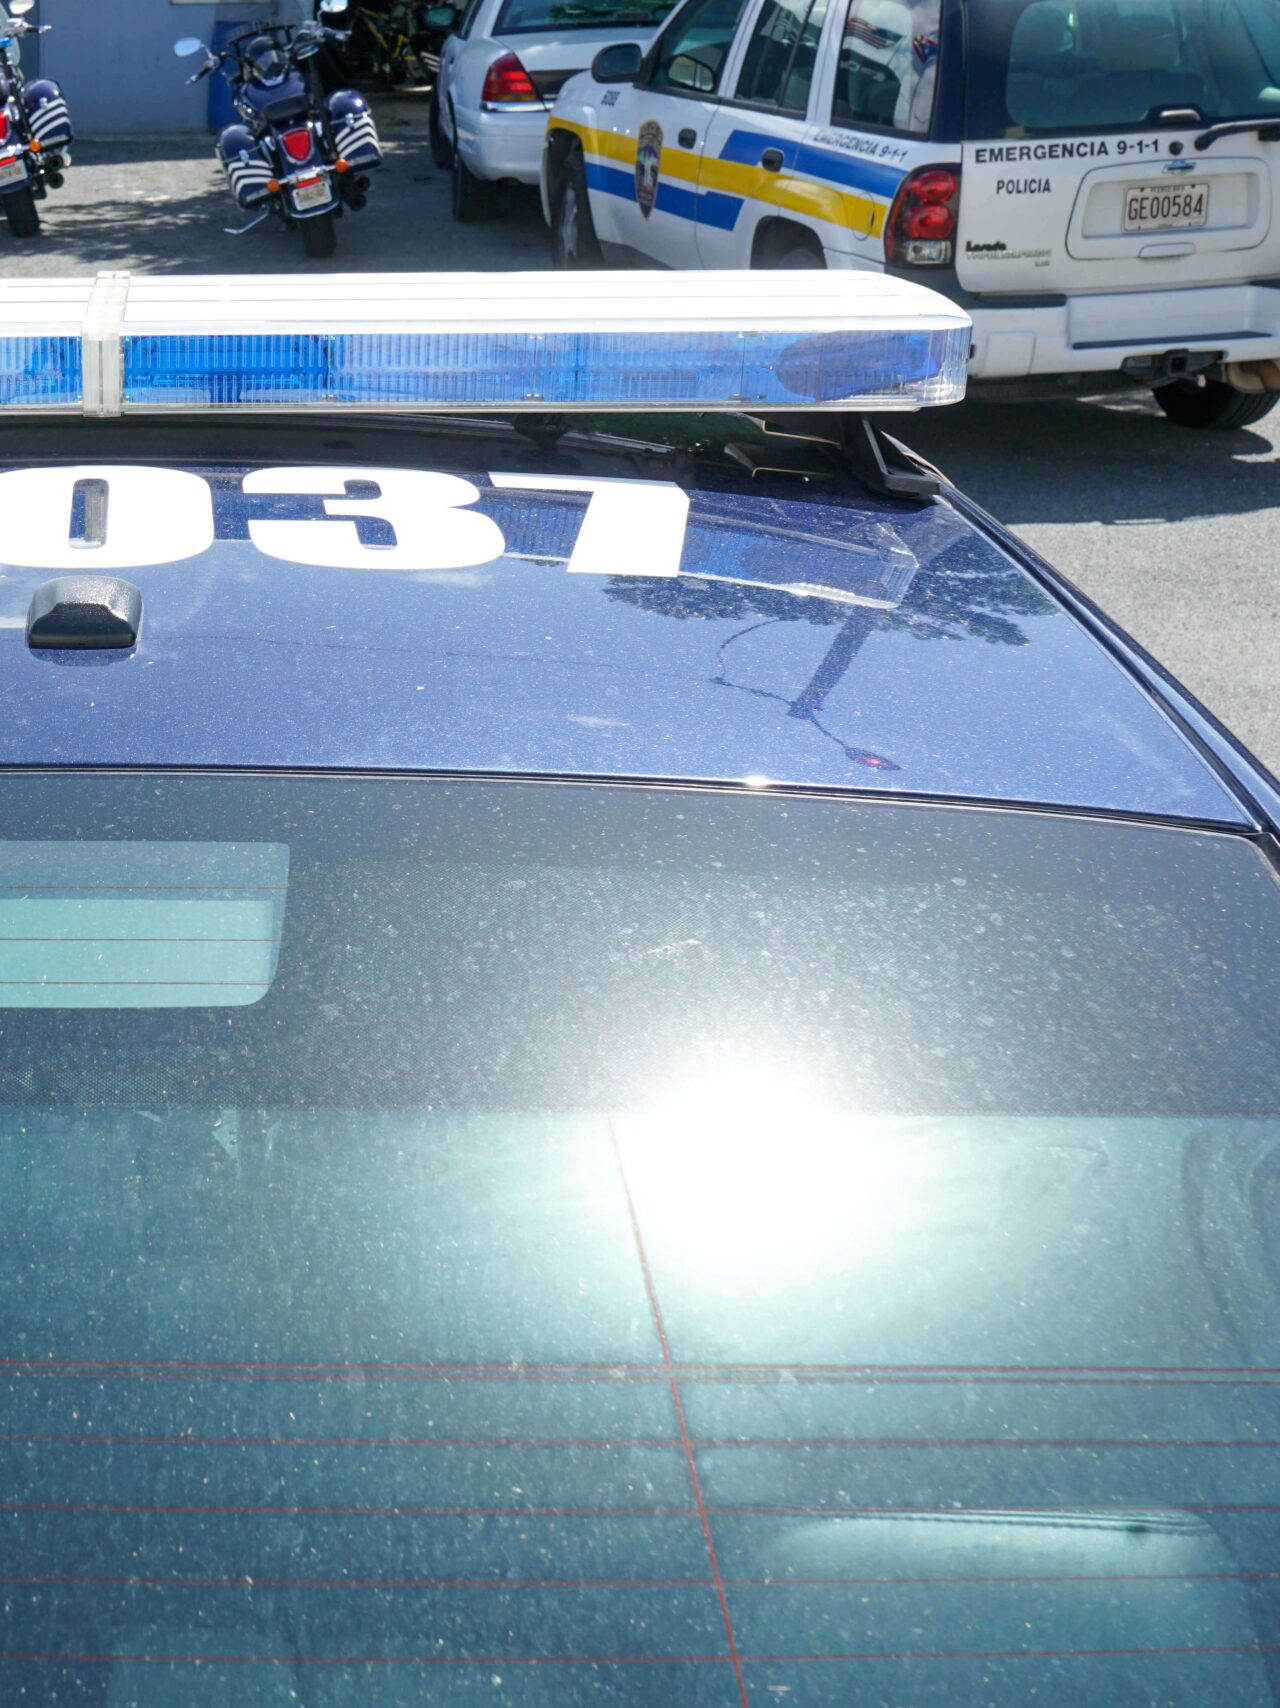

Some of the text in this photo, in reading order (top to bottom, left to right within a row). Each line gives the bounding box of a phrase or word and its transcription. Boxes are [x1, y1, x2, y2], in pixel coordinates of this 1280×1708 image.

[975, 139, 1159, 164] EMERGENCIA 9-1-1
[996, 178, 1051, 195] POLICIA
[1128, 194, 1204, 221] GE00584
